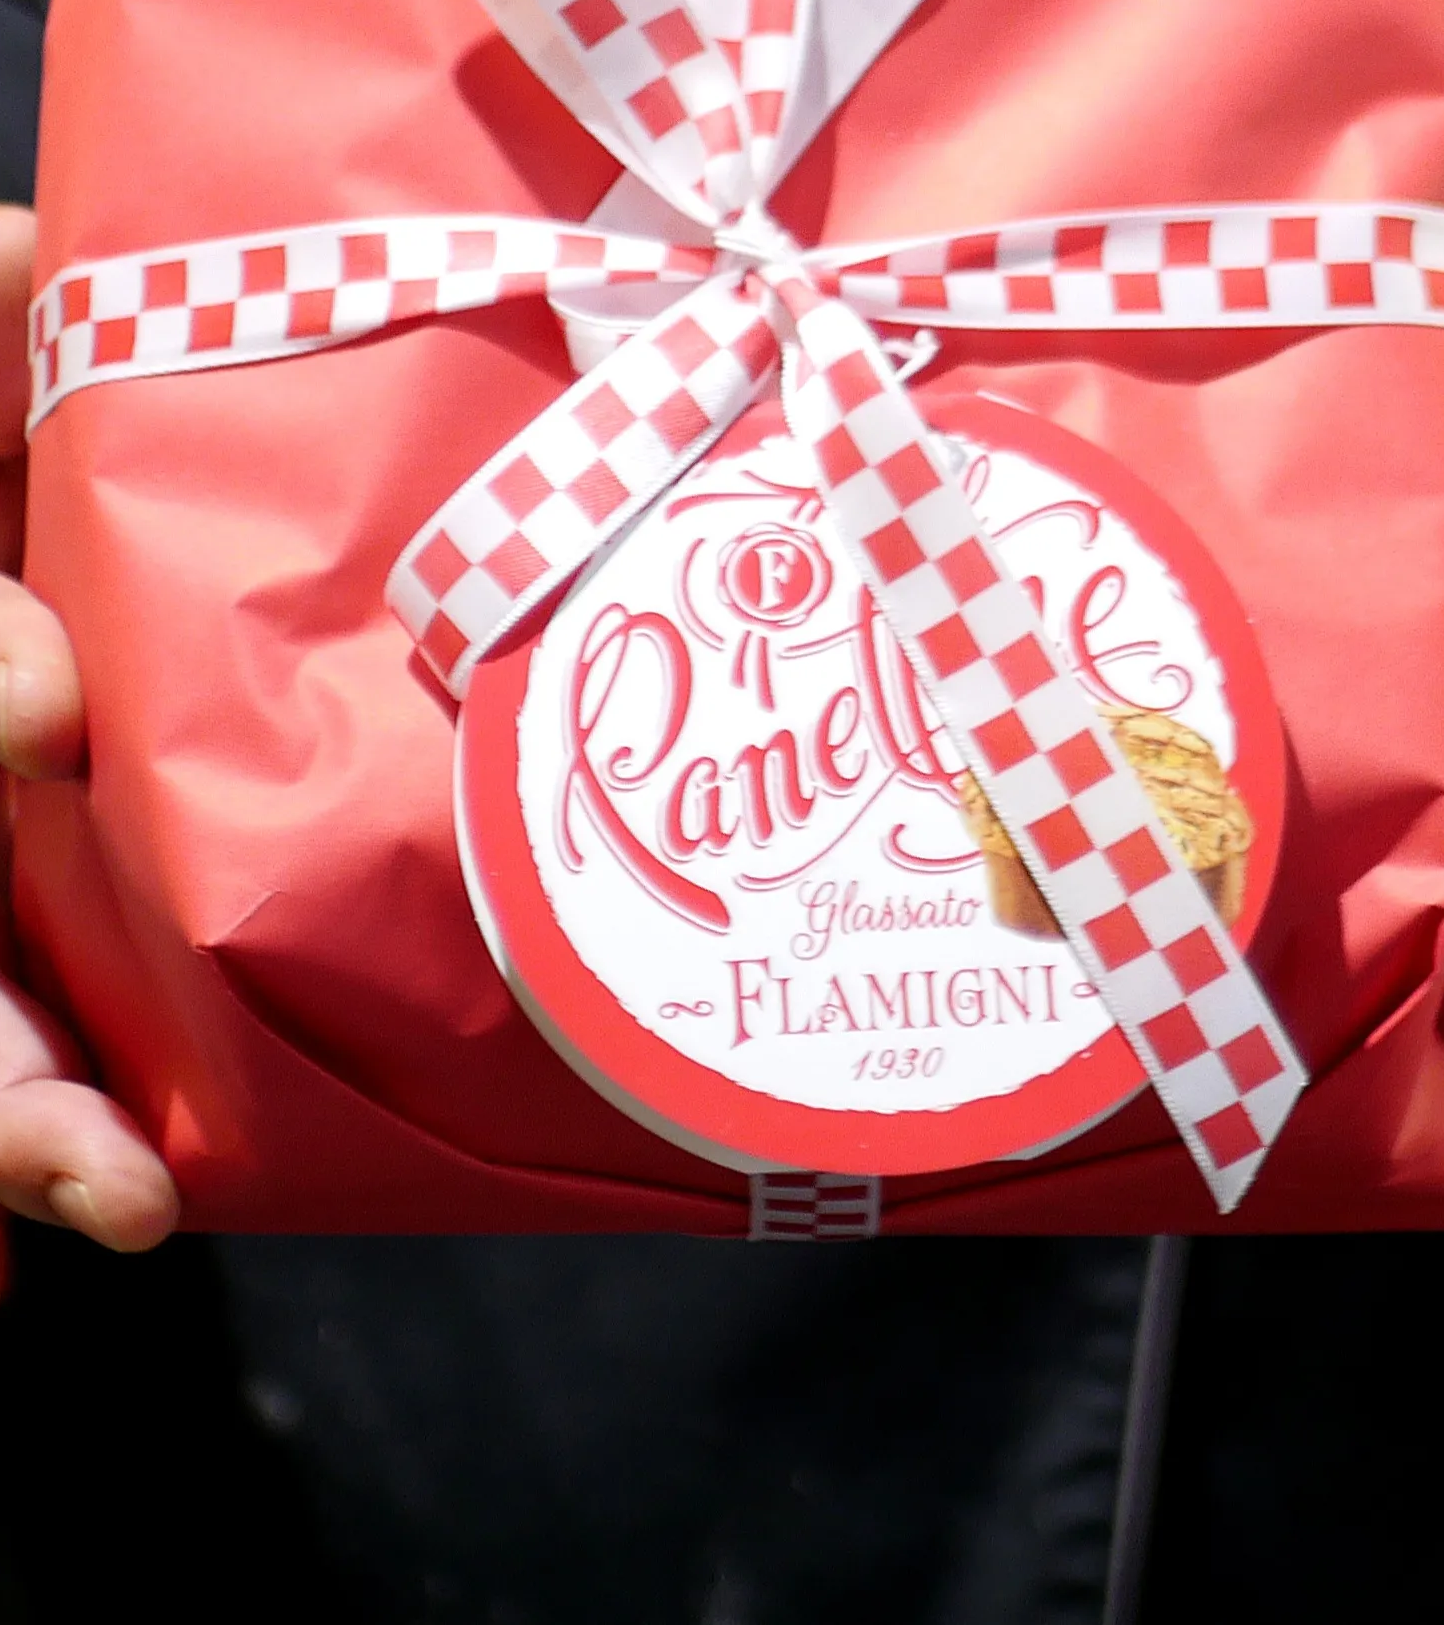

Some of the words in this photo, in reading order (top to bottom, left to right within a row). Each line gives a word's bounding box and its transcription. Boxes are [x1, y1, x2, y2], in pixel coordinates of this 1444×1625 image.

[756, 544, 795, 610] F
[559, 563, 1193, 932] Panette
[789, 879, 985, 960] Glassato
[723, 956, 1062, 1049] FLAMIGNI
[850, 1046, 945, 1081] 1930
